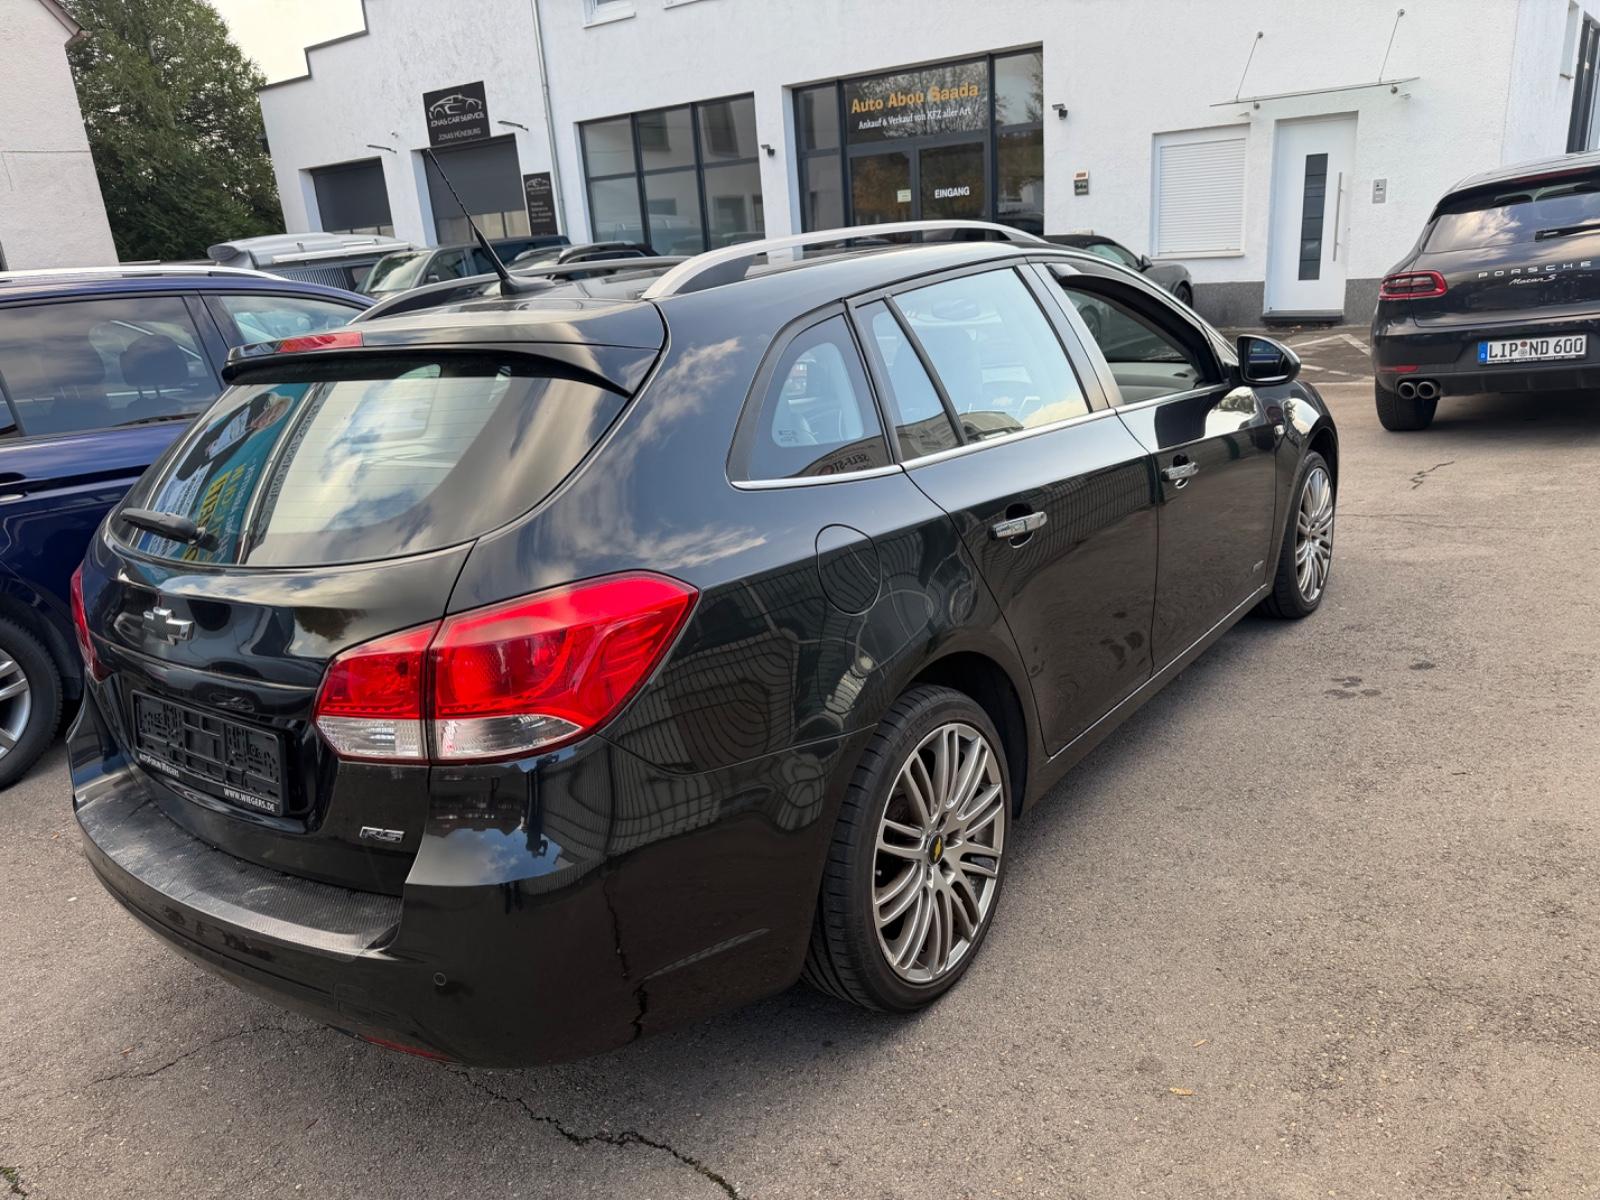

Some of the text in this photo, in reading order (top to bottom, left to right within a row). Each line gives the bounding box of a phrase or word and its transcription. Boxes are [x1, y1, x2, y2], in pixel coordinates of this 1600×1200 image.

[851, 83, 978, 113] Auto Abou Saada
[447, 116, 460, 124] CAR
[858, 117, 882, 130] Ankauf
[888, 113, 913, 125] Verkauf
[914, 113, 926, 121] von
[927, 110, 941, 120] KFZ
[942, 107, 959, 118] aller
[959, 107, 971, 116] Art
[934, 186, 970, 199] EINGANG
[1479, 261, 1591, 278] PORSCHE
[1508, 277, 1544, 286] Macan
[1488, 343, 1519, 359] LIP
[1528, 340, 1550, 356] ND
[1553, 337, 1584, 354] 600
[223, 788, 275, 812] WWW.WIEGERS.DE
[359, 826, 405, 843] RS
